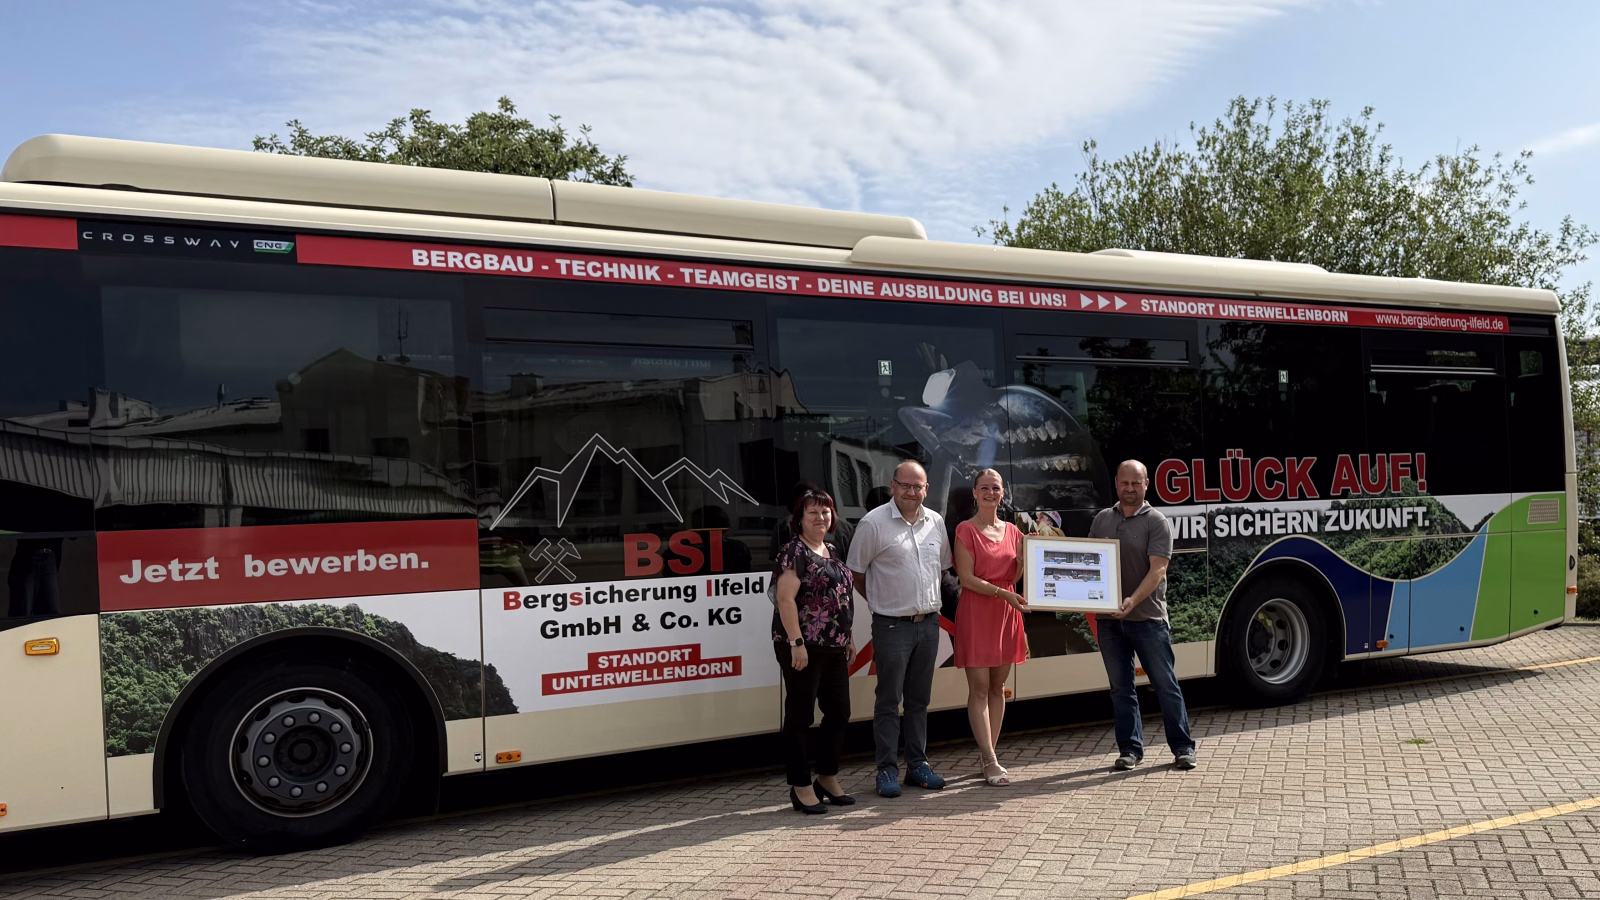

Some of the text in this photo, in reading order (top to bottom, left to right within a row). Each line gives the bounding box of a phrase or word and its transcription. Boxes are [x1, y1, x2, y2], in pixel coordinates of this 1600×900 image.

[82, 231, 240, 249] CROSSWAY
[255, 241, 283, 250] CNG
[412, 249, 533, 273] BERGBAU
[555, 258, 662, 282] TECHNIK
[680, 268, 800, 291] TEAMGEIST
[817, 278, 875, 297] DEINE
[880, 282, 993, 304] AUSBILDUNG
[997, 290, 1025, 305] BEI
[1029, 292, 1067, 307] UNS!
[1140, 299, 1348, 323] STANDORT UNTERWELLENBORN
[1375, 313, 1504, 331] www.bergsicherung-ilfeld.de
[1155, 448, 1427, 504] GLÜCK AUF!
[1214, 510, 1318, 537] SICHERN
[1324, 506, 1430, 532] ZUKUNFT.
[120, 549, 430, 584] Jetzt bewerben.
[623, 529, 724, 577] BSI
[503, 576, 765, 612] Bergsicherung Ilfeld
[540, 607, 743, 639] GmbH & Co. KG
[552, 648, 733, 691] STANDORT UNTERWELLENBORN
